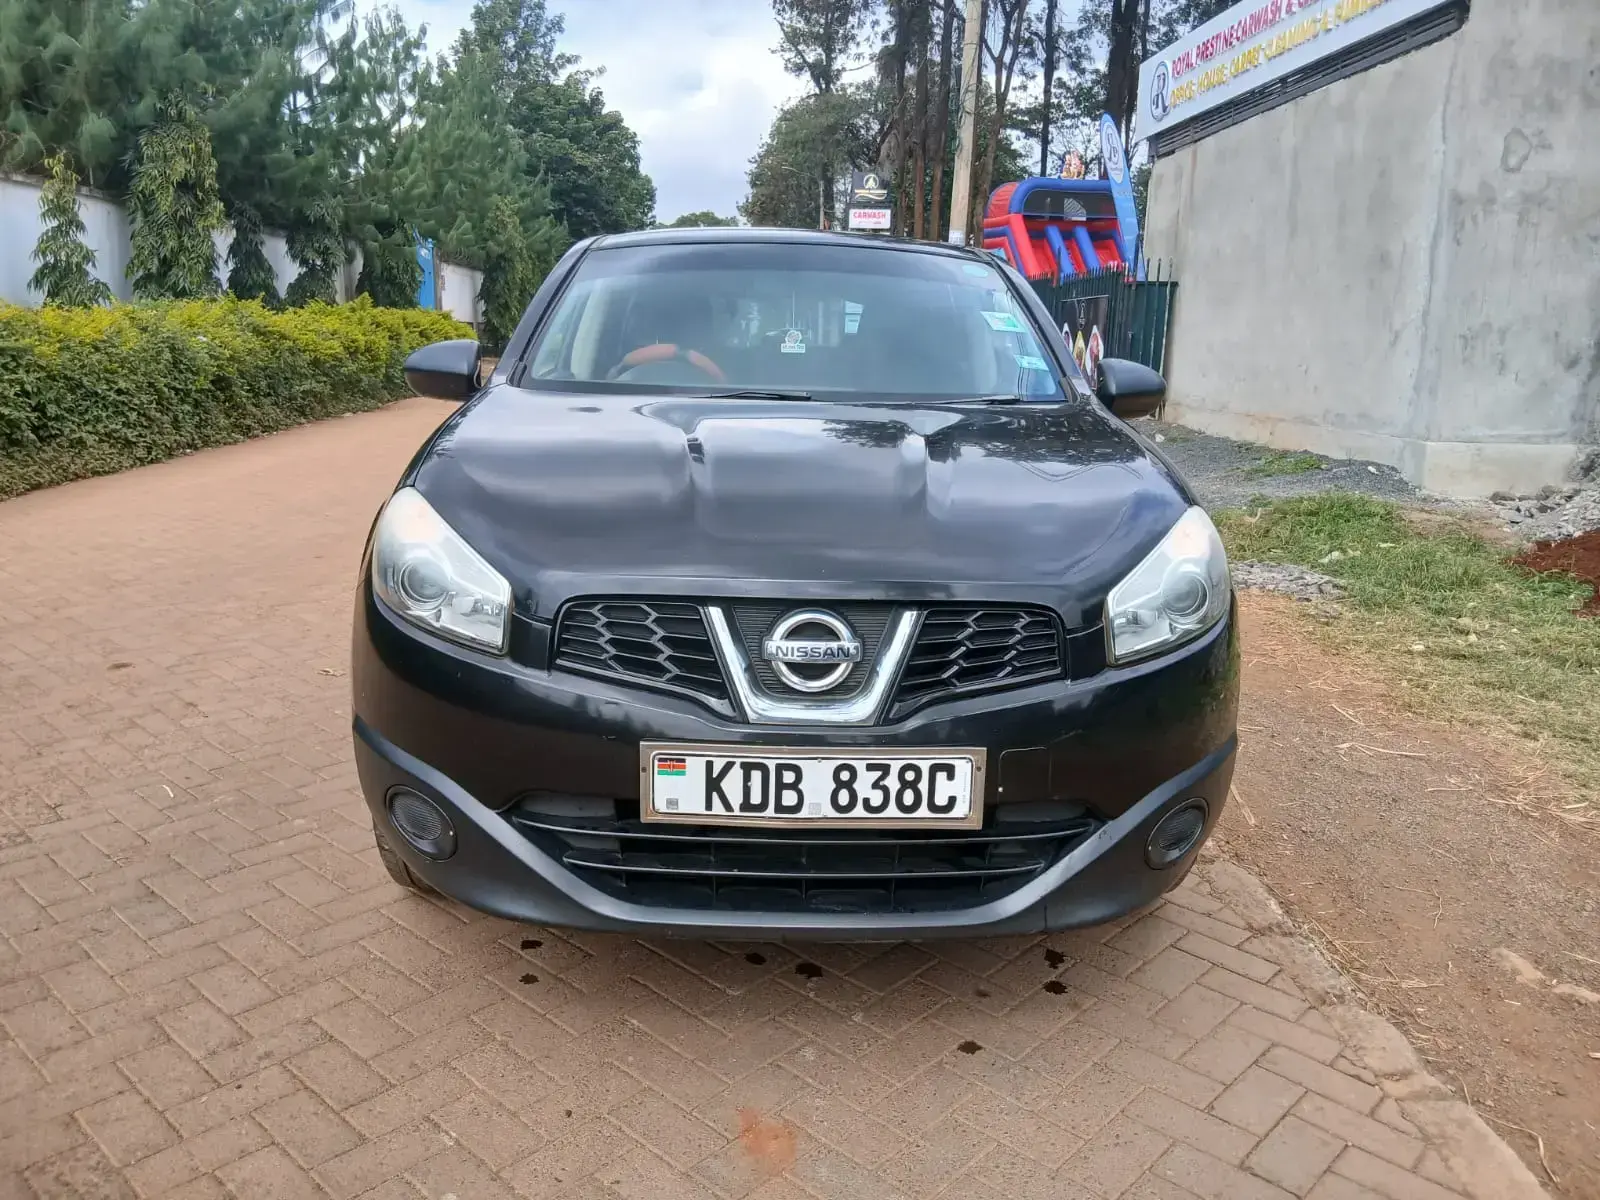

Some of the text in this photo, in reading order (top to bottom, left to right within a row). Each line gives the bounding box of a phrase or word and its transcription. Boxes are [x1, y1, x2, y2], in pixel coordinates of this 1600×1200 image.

[1171, 48, 1195, 79] ROYAL
[852, 211, 887, 220] CARWASH
[775, 645, 851, 659] NISSAN
[704, 759, 805, 815] KDB
[829, 762, 957, 815] 838C
